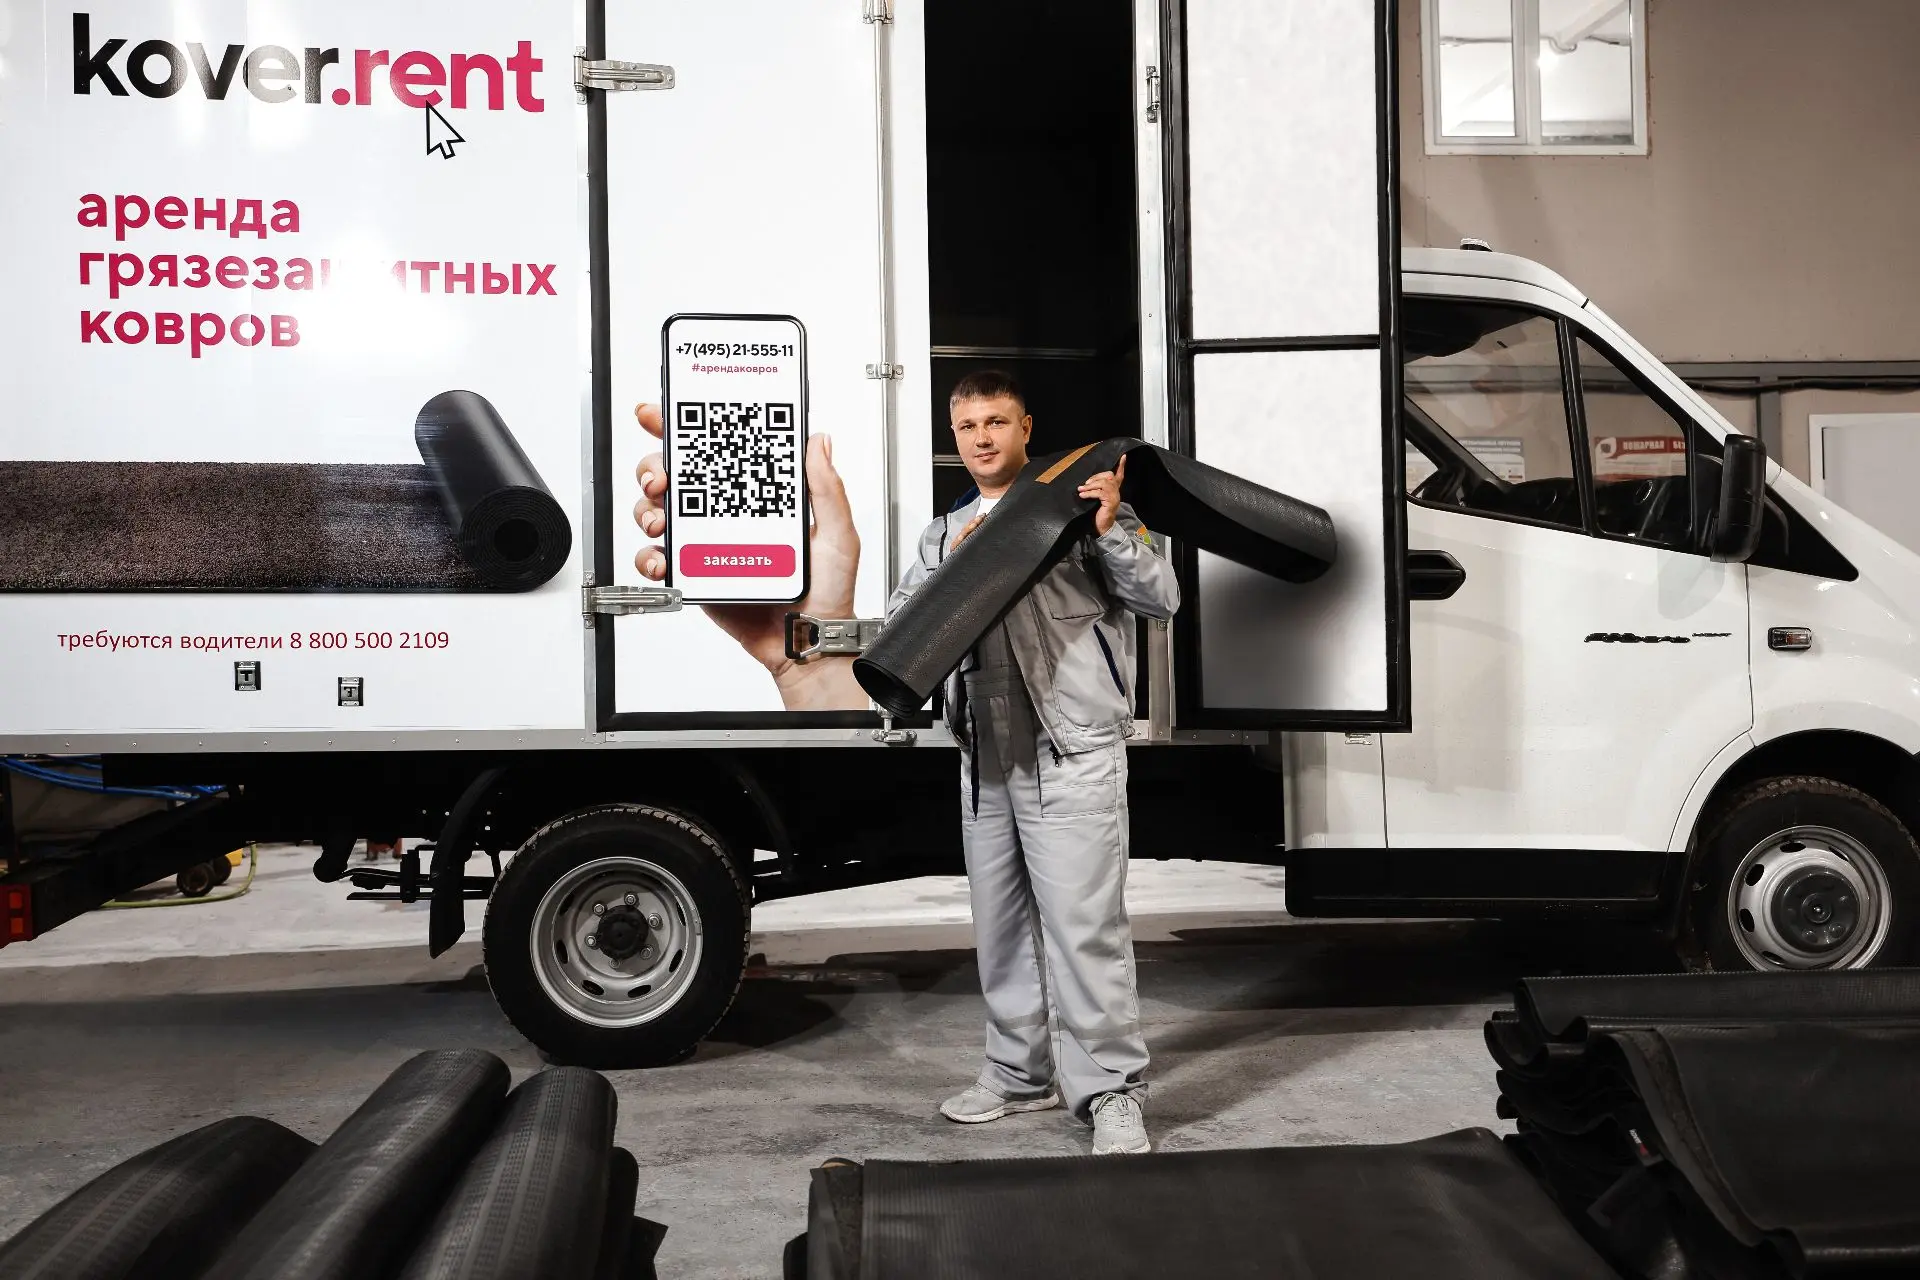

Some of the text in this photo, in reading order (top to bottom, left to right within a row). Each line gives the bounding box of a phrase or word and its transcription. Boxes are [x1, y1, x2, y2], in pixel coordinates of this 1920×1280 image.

[73, 13, 544, 113] kover.rent
[77, 193, 300, 241] аренда
[79, 252, 557, 299] грязезатных
[80, 310, 301, 359] ковров
[691, 363, 779, 375] #арендаковров
[703, 556, 773, 566] заказать
[57, 630, 450, 652] требуются водители 8 800 500 2109
